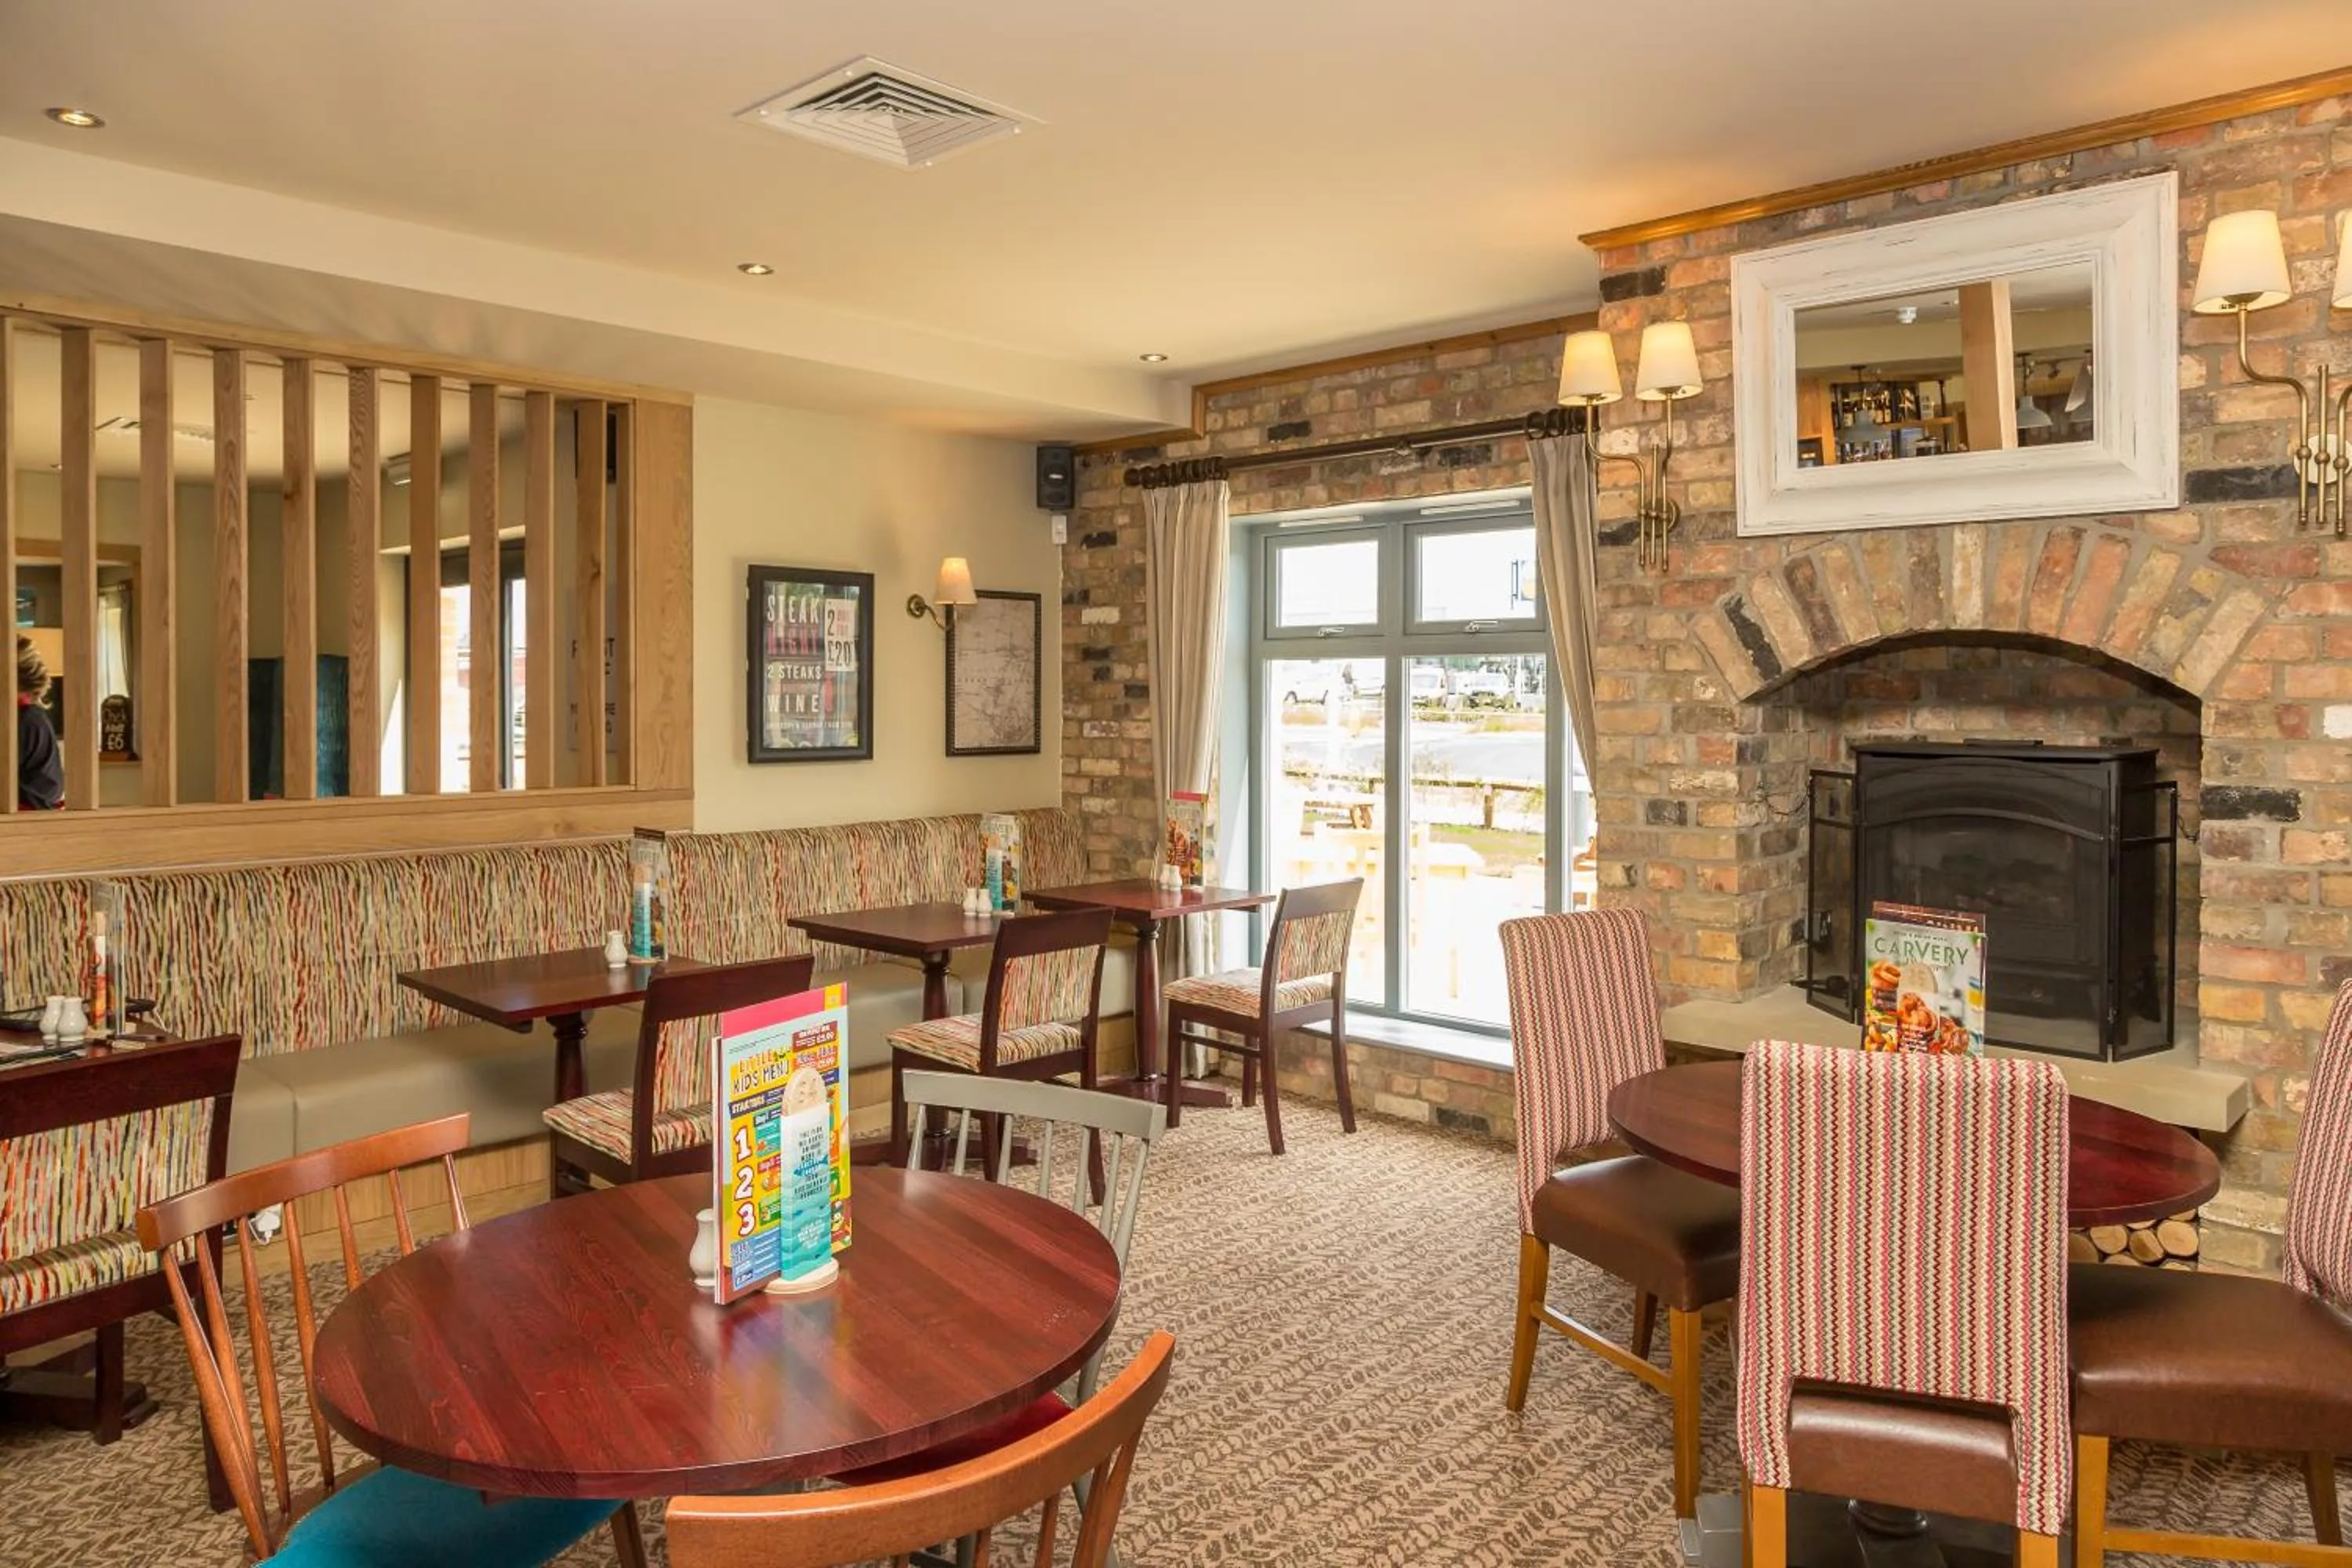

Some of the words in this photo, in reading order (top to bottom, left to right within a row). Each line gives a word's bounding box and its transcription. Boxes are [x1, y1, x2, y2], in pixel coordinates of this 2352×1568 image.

[768, 595, 819, 623] STEAK
[828, 609, 835, 636] 2
[768, 627, 819, 655] NIGHT
[768, 665, 774, 677] 2
[778, 665, 822, 680] STEAKS
[768, 694, 819, 713] WINE
[1874, 937, 1969, 965] CARVERY
[733, 1069, 759, 1094] KIDS
[763, 1059, 790, 1083] MENU
[735, 1127, 753, 1162] 1
[734, 1165, 754, 1200] 2
[737, 1201, 756, 1236] 3
